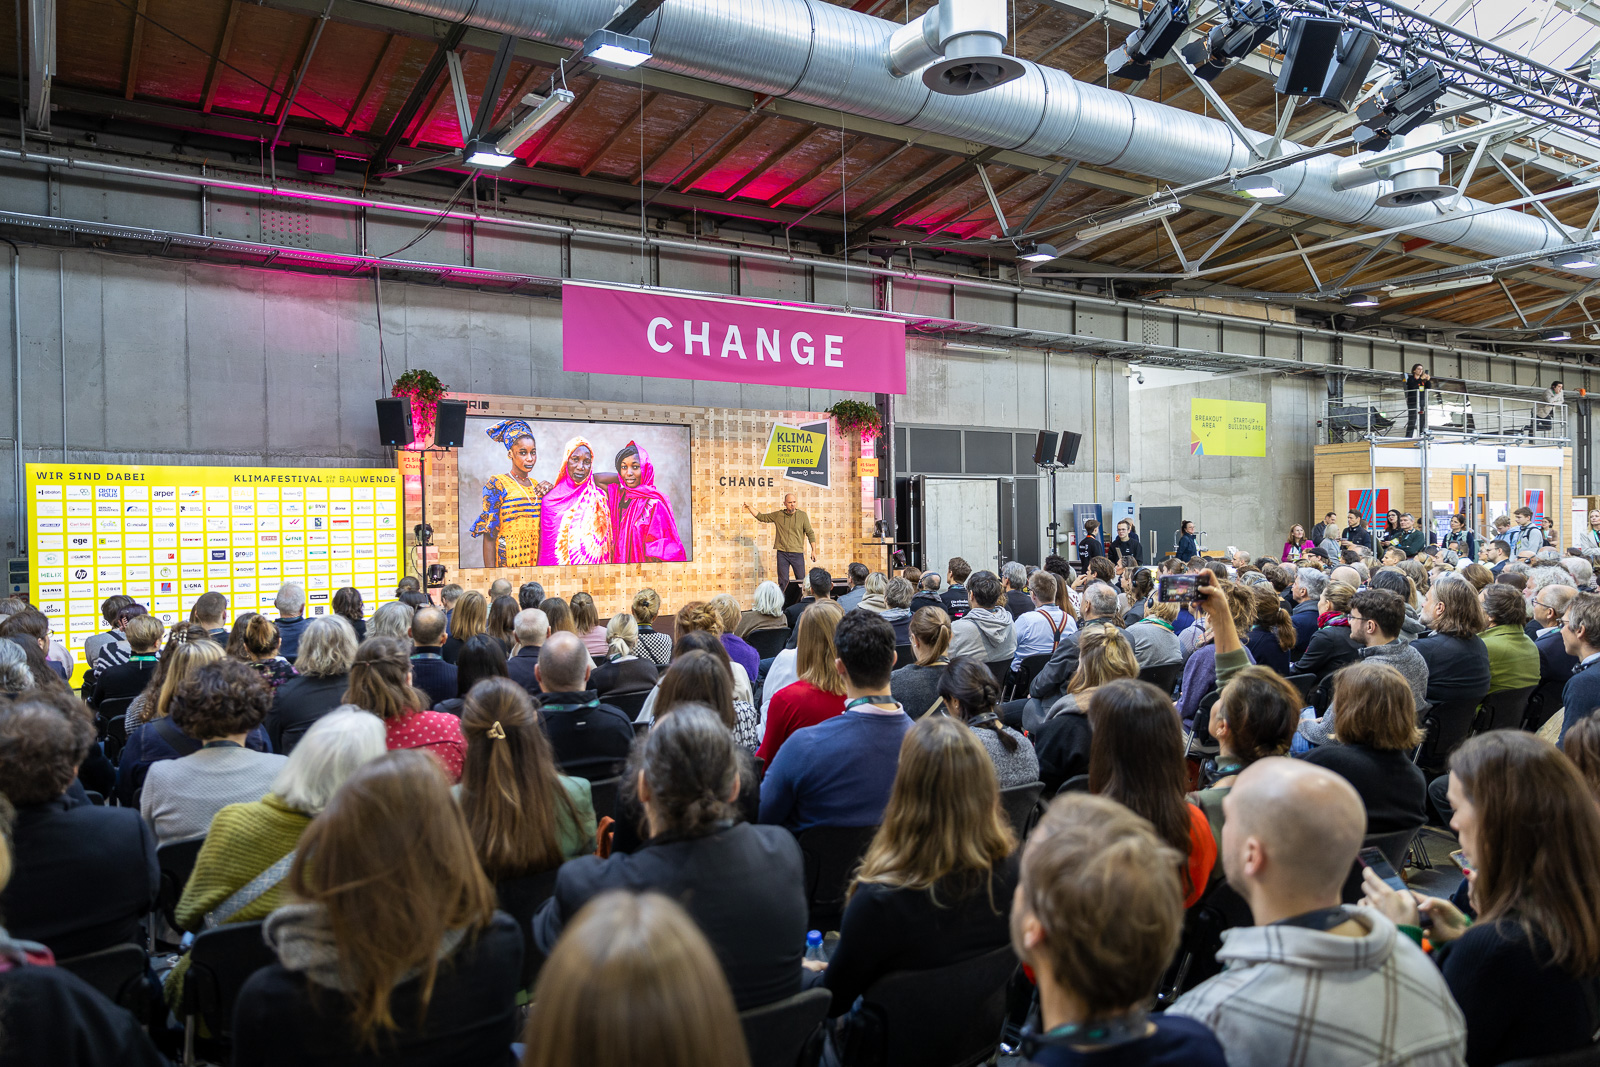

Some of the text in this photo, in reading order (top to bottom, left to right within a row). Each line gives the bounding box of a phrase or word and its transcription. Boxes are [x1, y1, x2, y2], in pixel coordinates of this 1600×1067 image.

[646, 316, 844, 368] CHANGE
[1195, 414, 1222, 422] BREAKOUT
[777, 432, 813, 443] KLIMA
[777, 444, 814, 453] FESTIVAL
[36, 471, 145, 481] WIR SIND DABEI
[234, 475, 322, 483] KLIMAFESTIVAL
[339, 475, 396, 483] BAUWENDE
[719, 476, 774, 487] CHANGE
